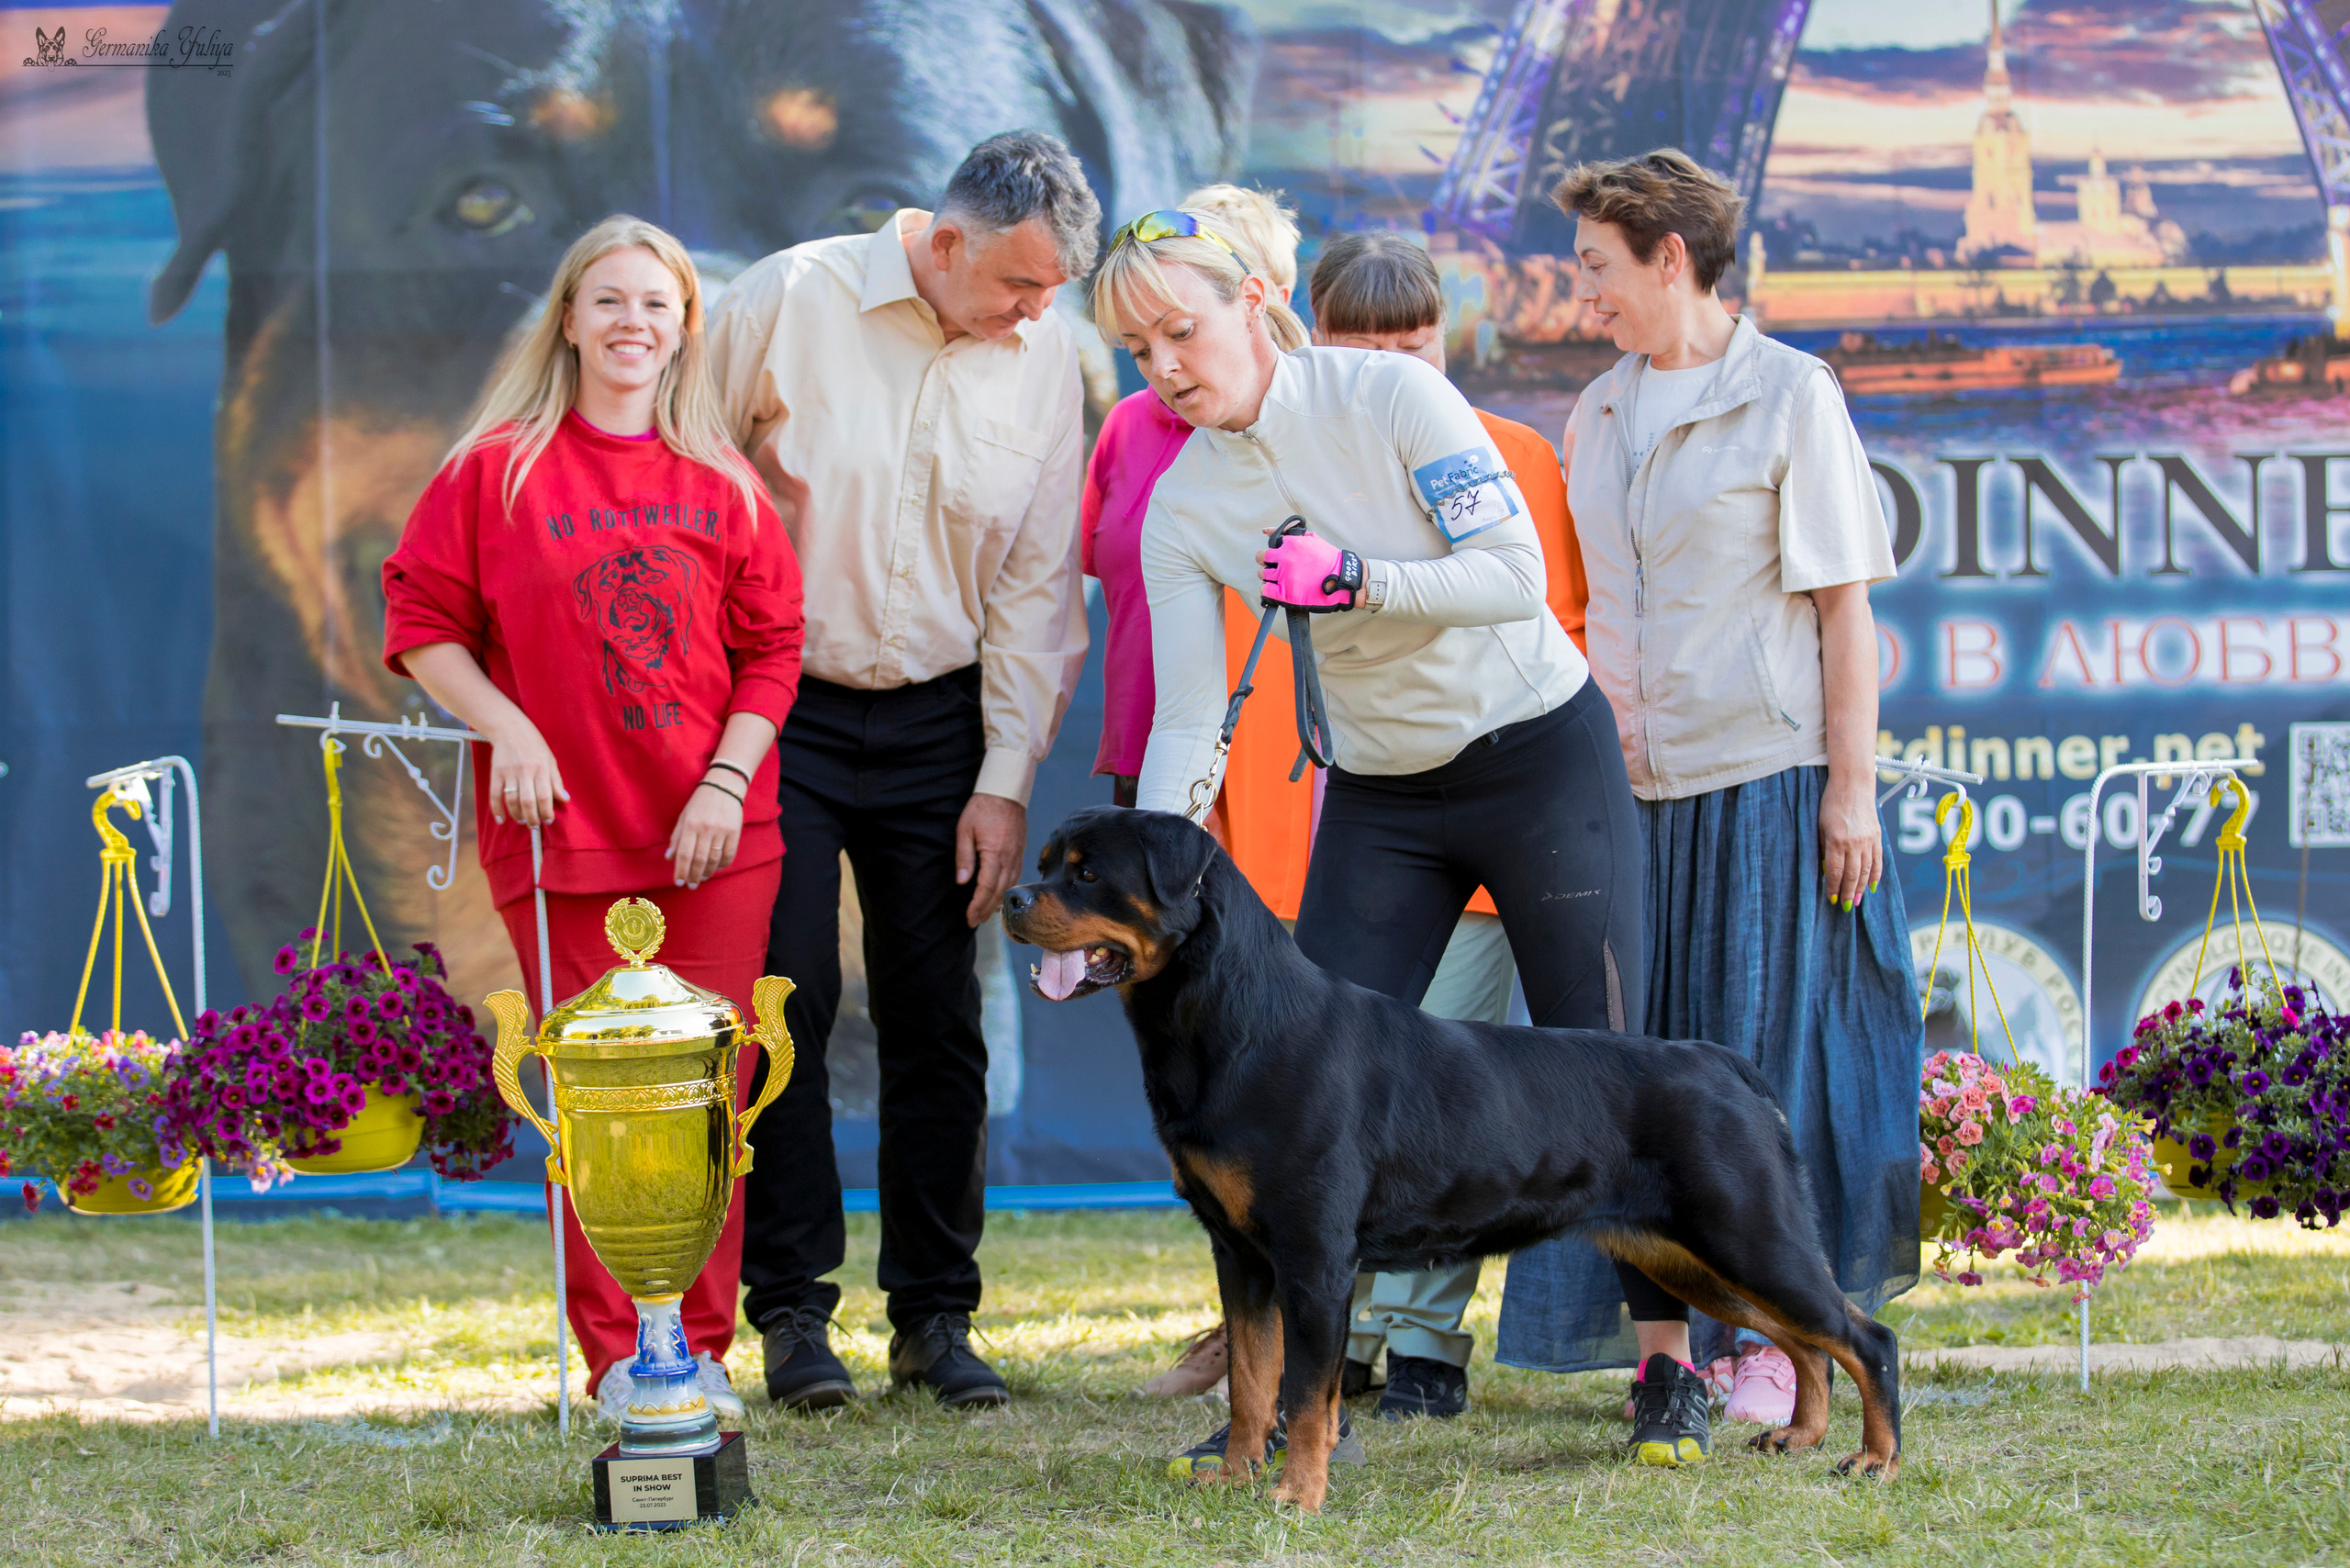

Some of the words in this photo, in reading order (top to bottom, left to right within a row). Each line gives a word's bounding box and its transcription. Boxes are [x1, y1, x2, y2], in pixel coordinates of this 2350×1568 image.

[1450, 489, 1482, 521] 57
[544, 513, 576, 542] NO
[1938, 620, 2003, 689] В
[622, 705, 646, 732] NO
[653, 701, 684, 729] LIFE
